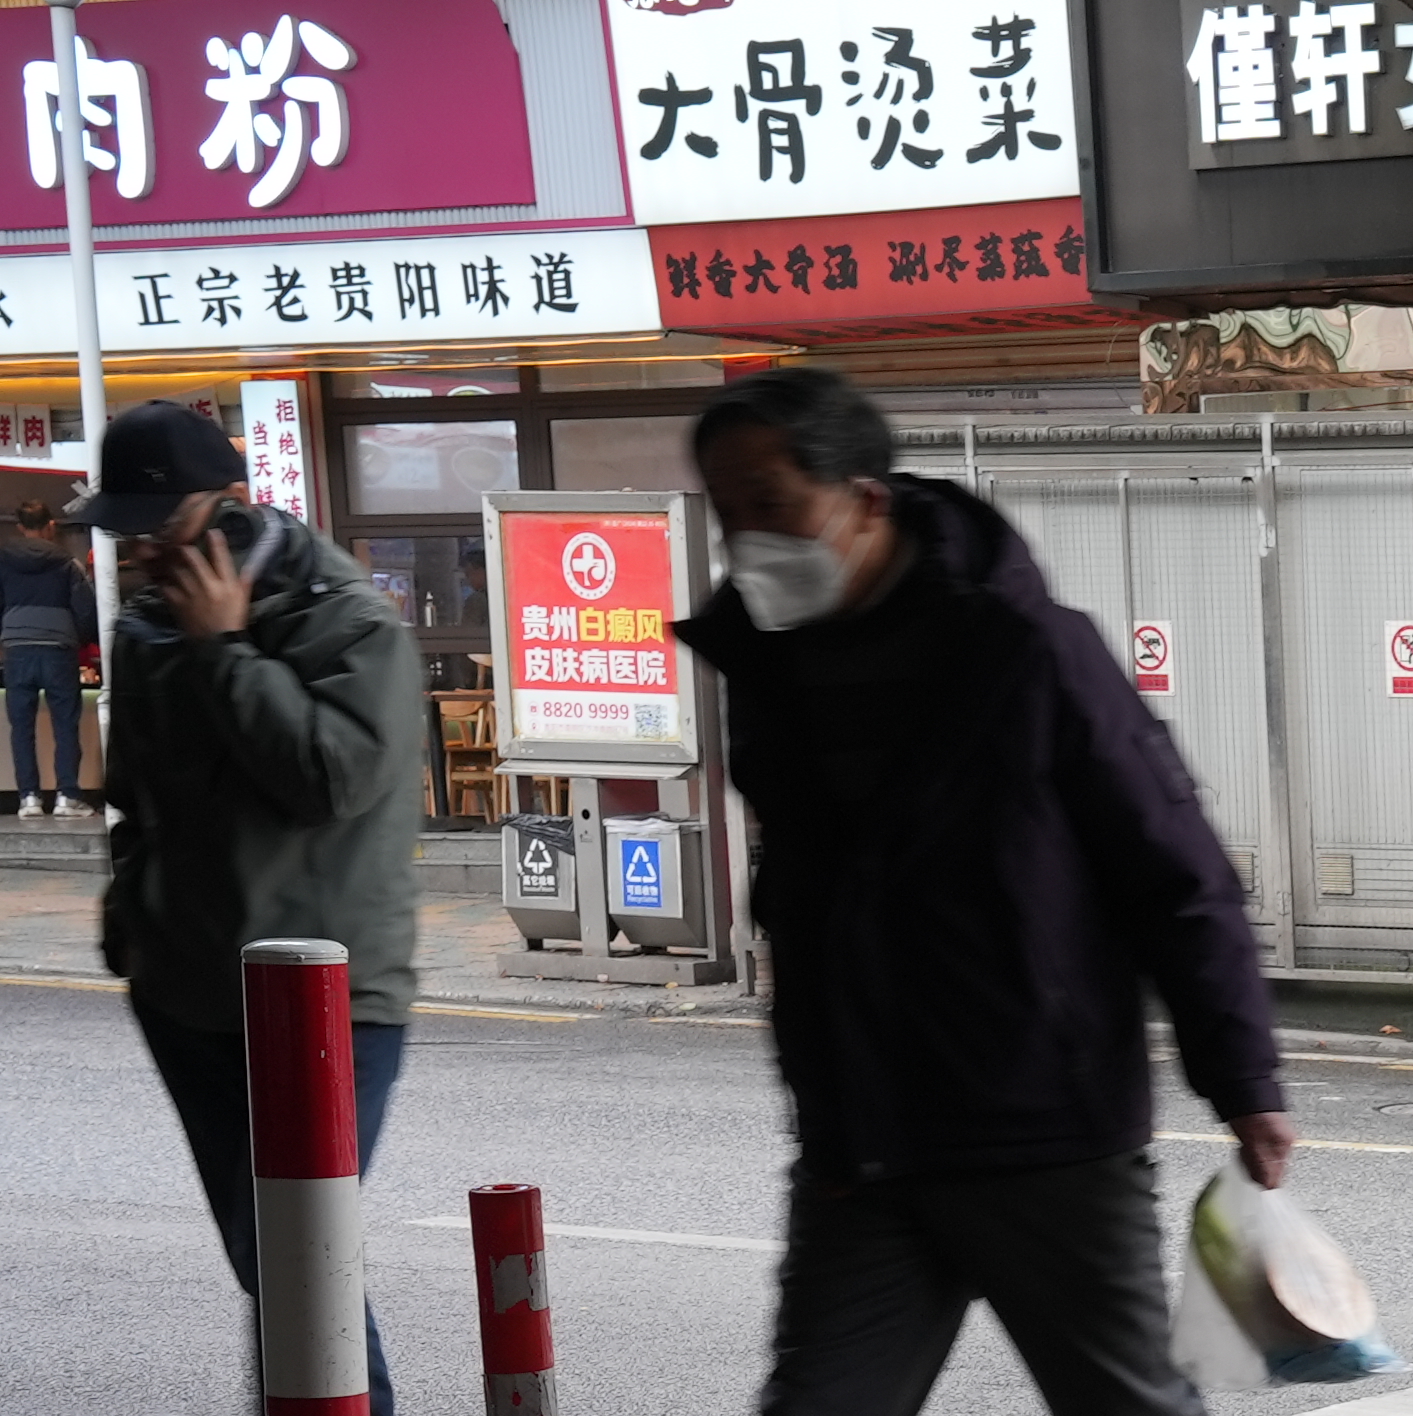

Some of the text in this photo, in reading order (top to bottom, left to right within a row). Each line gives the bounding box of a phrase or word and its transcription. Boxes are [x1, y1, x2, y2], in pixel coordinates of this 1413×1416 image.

[23, 13, 358, 209] 肉粉
[638, 12, 1063, 185] 大骨烫菜
[132, 251, 581, 328] 正宗老贵阳味道
[665, 242, 859, 300] 鲜香大骨汤
[274, 398, 308, 521] 拒绝冷冻
[521, 604, 665, 644] 贵州白癜风
[524, 647, 668, 686] 皮肤病医院
[543, 702, 629, 720] 8820 9999
